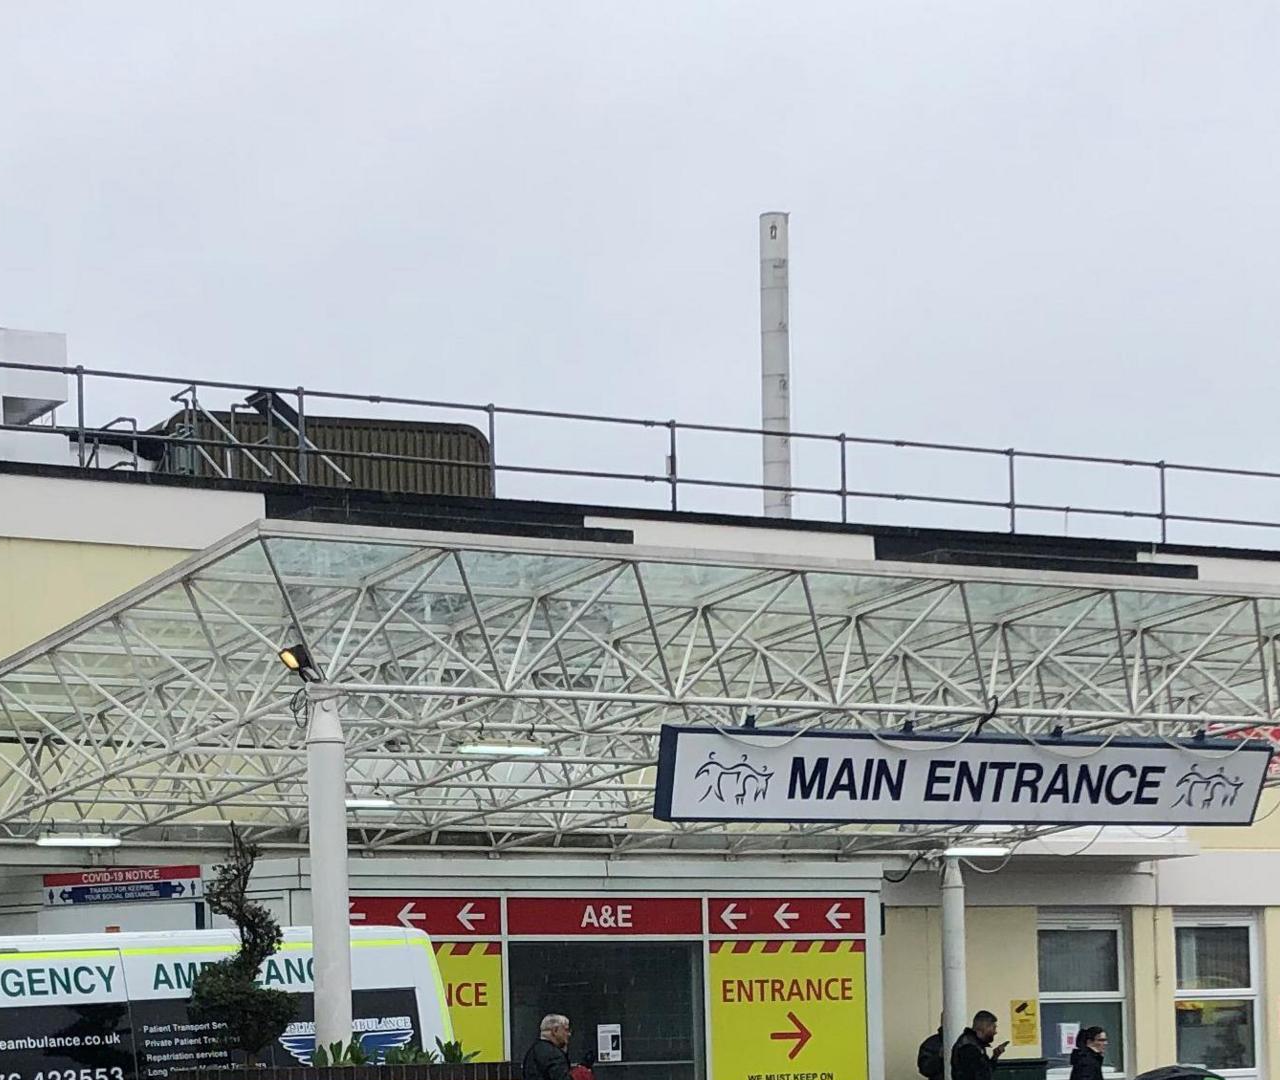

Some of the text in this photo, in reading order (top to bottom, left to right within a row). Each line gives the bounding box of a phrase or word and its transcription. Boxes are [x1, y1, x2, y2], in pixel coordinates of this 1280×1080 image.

[787, 756, 1167, 806] MAIN ENTRANCE
[81, 868, 161, 884] COVID-19 NOTICE
[580, 904, 633, 929] A&E
[721, 977, 854, 1003] ENTRANCE
[143, 1023, 172, 1034] Patient
[172, 1021, 210, 1033] Transport
[351, 1017, 411, 1031] MBULANCE
[144, 1039, 173, 1048] Private
[174, 1037, 202, 1046] Patient
[146, 1050, 228, 1063] Repatriation services
[148, 1067, 169, 1078] Long
